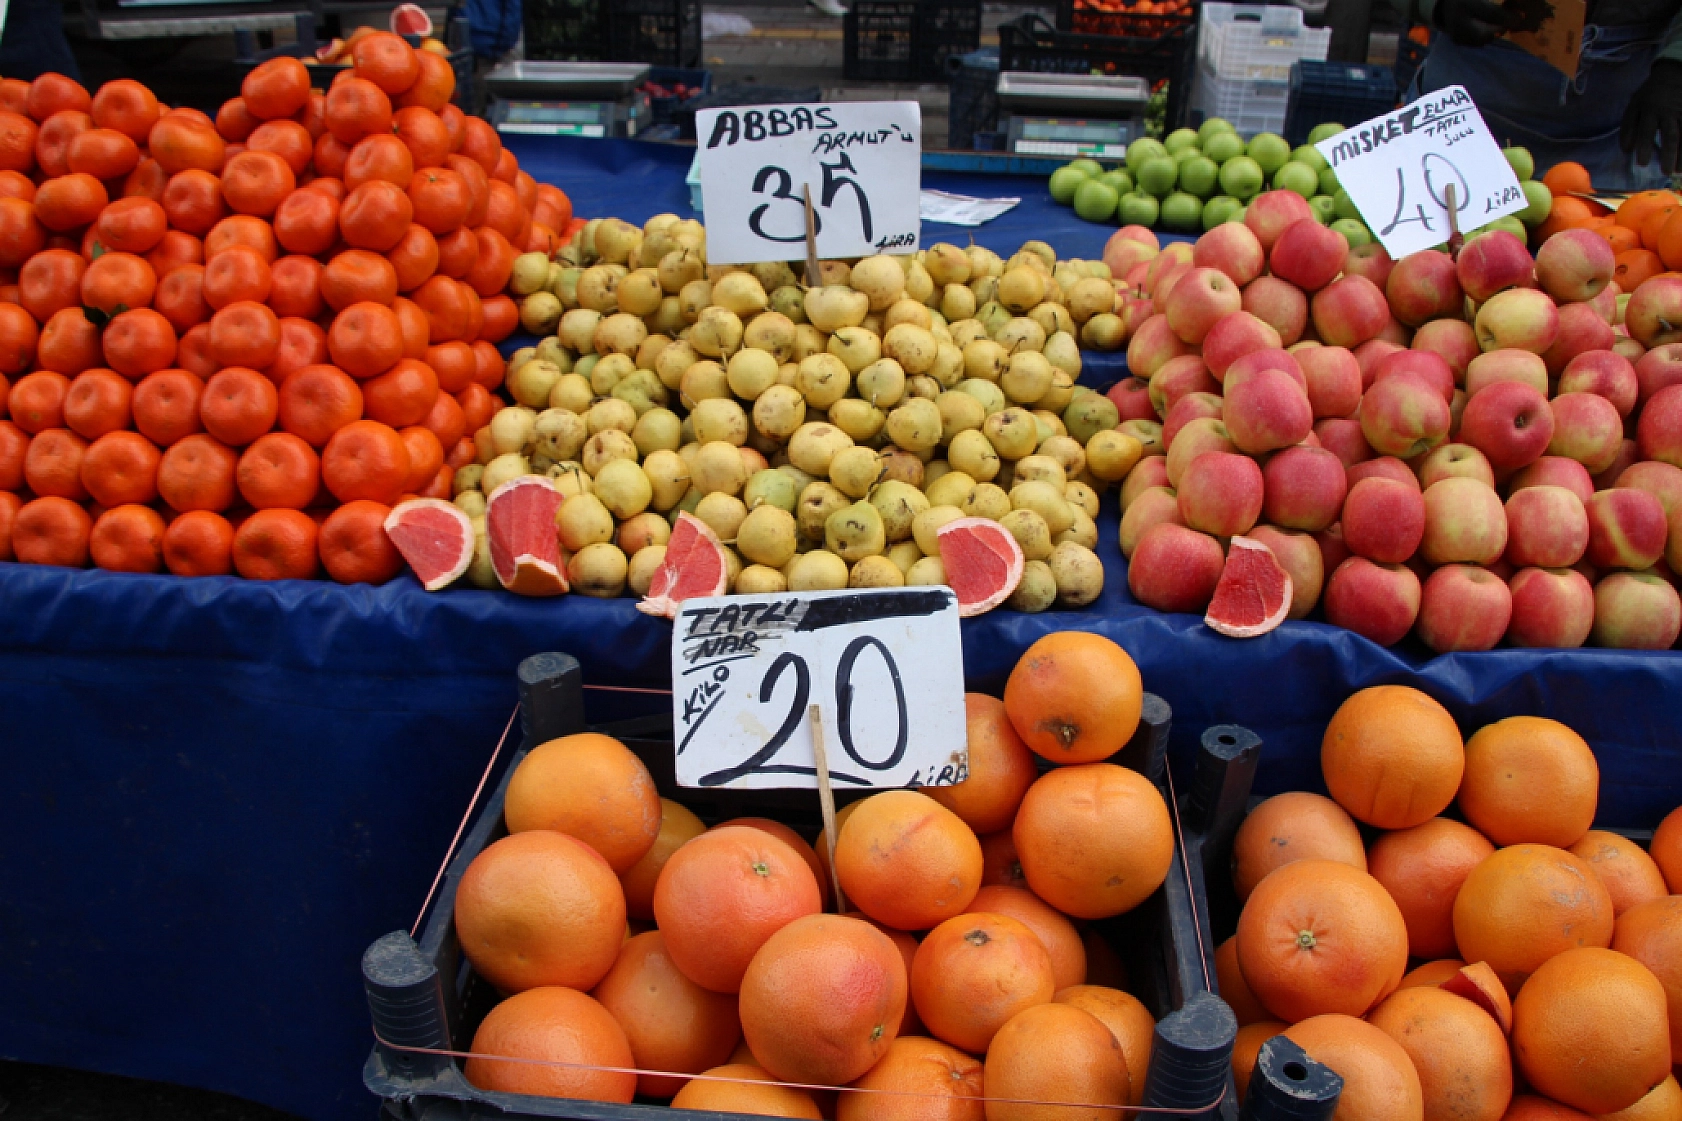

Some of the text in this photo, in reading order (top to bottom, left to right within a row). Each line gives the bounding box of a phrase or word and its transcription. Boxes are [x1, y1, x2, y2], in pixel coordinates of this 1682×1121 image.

[1422, 89, 1471, 120] ELMA
[706, 106, 838, 149] ABBAS
[748, 151, 873, 243] 35
[1380, 151, 1471, 236] 40
[682, 598, 798, 632] TATLI
[690, 630, 760, 663] NAR
[697, 635, 908, 787] 20
